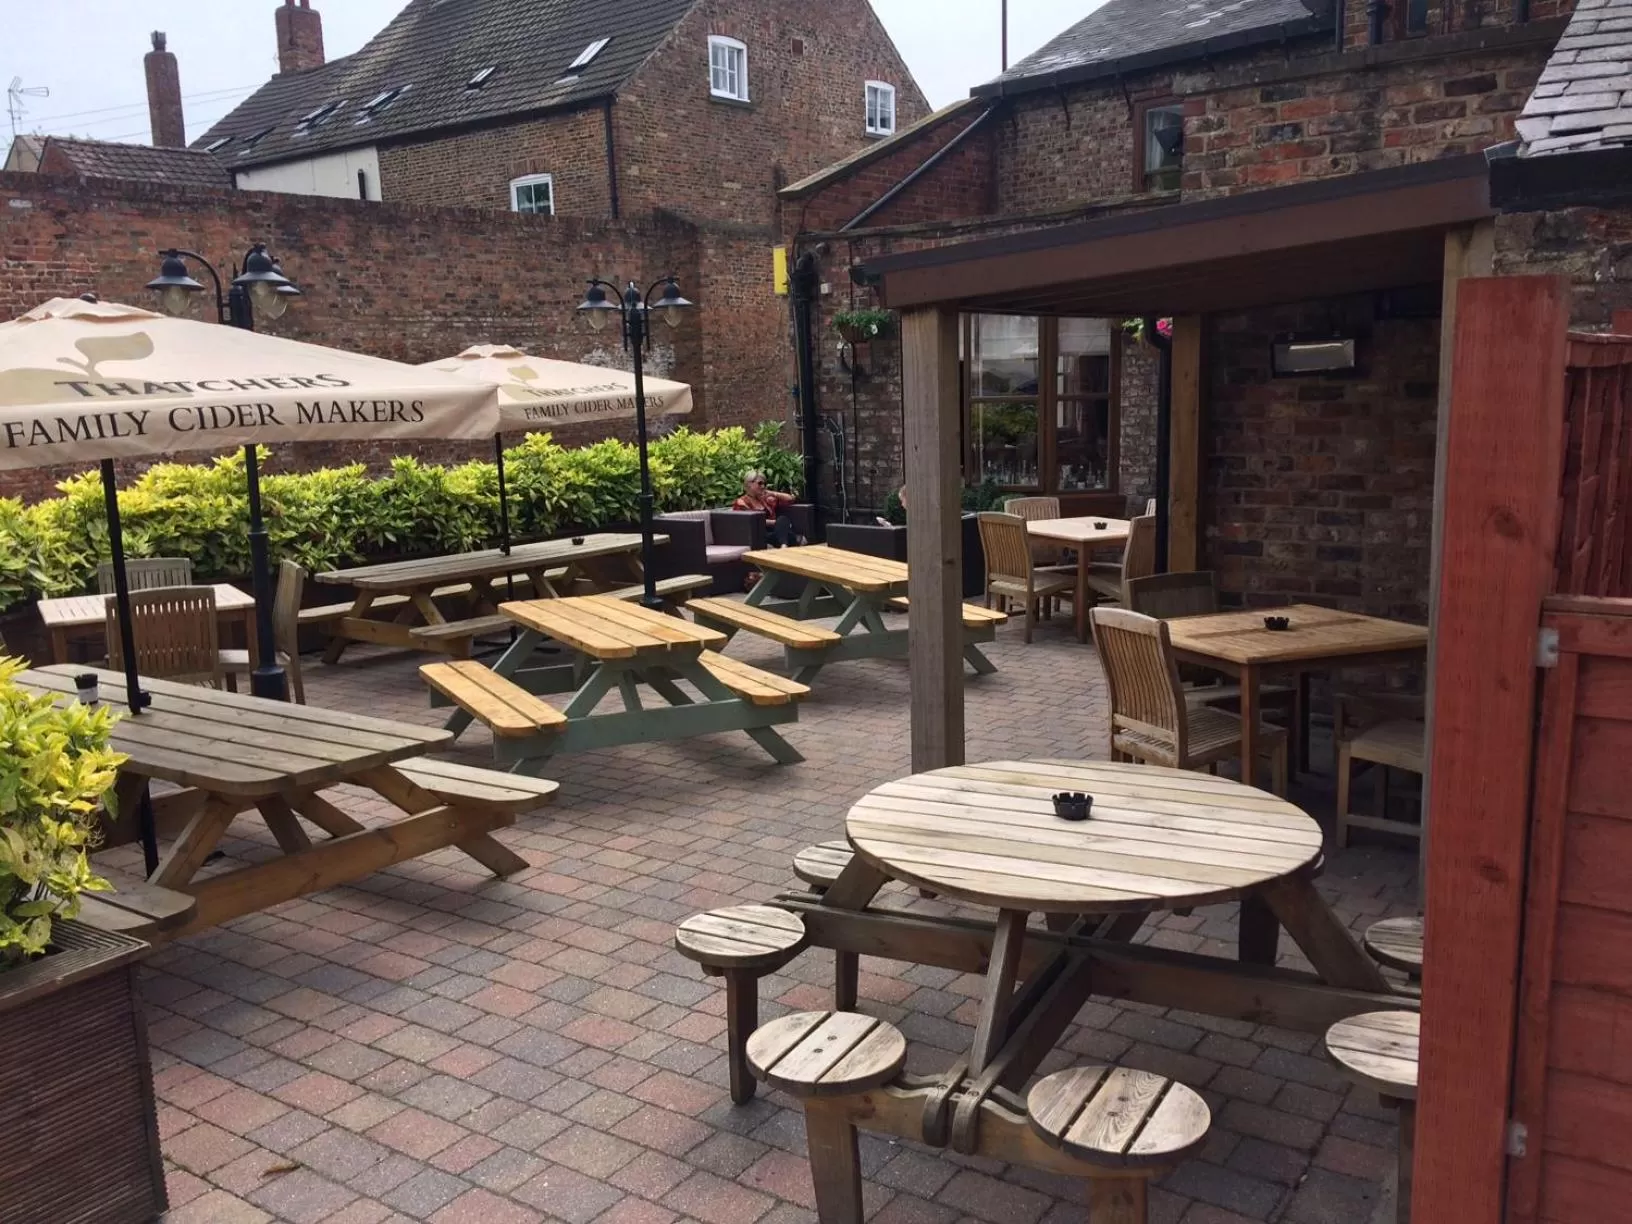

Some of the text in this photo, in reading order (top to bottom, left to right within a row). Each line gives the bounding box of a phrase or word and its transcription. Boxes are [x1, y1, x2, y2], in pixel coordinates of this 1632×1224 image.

[54, 373, 351, 397] THATCHERS
[524, 396, 664, 420] FAMILY CIDER MAERS
[2, 400, 425, 448] FAMILY CIDER MAKERS
